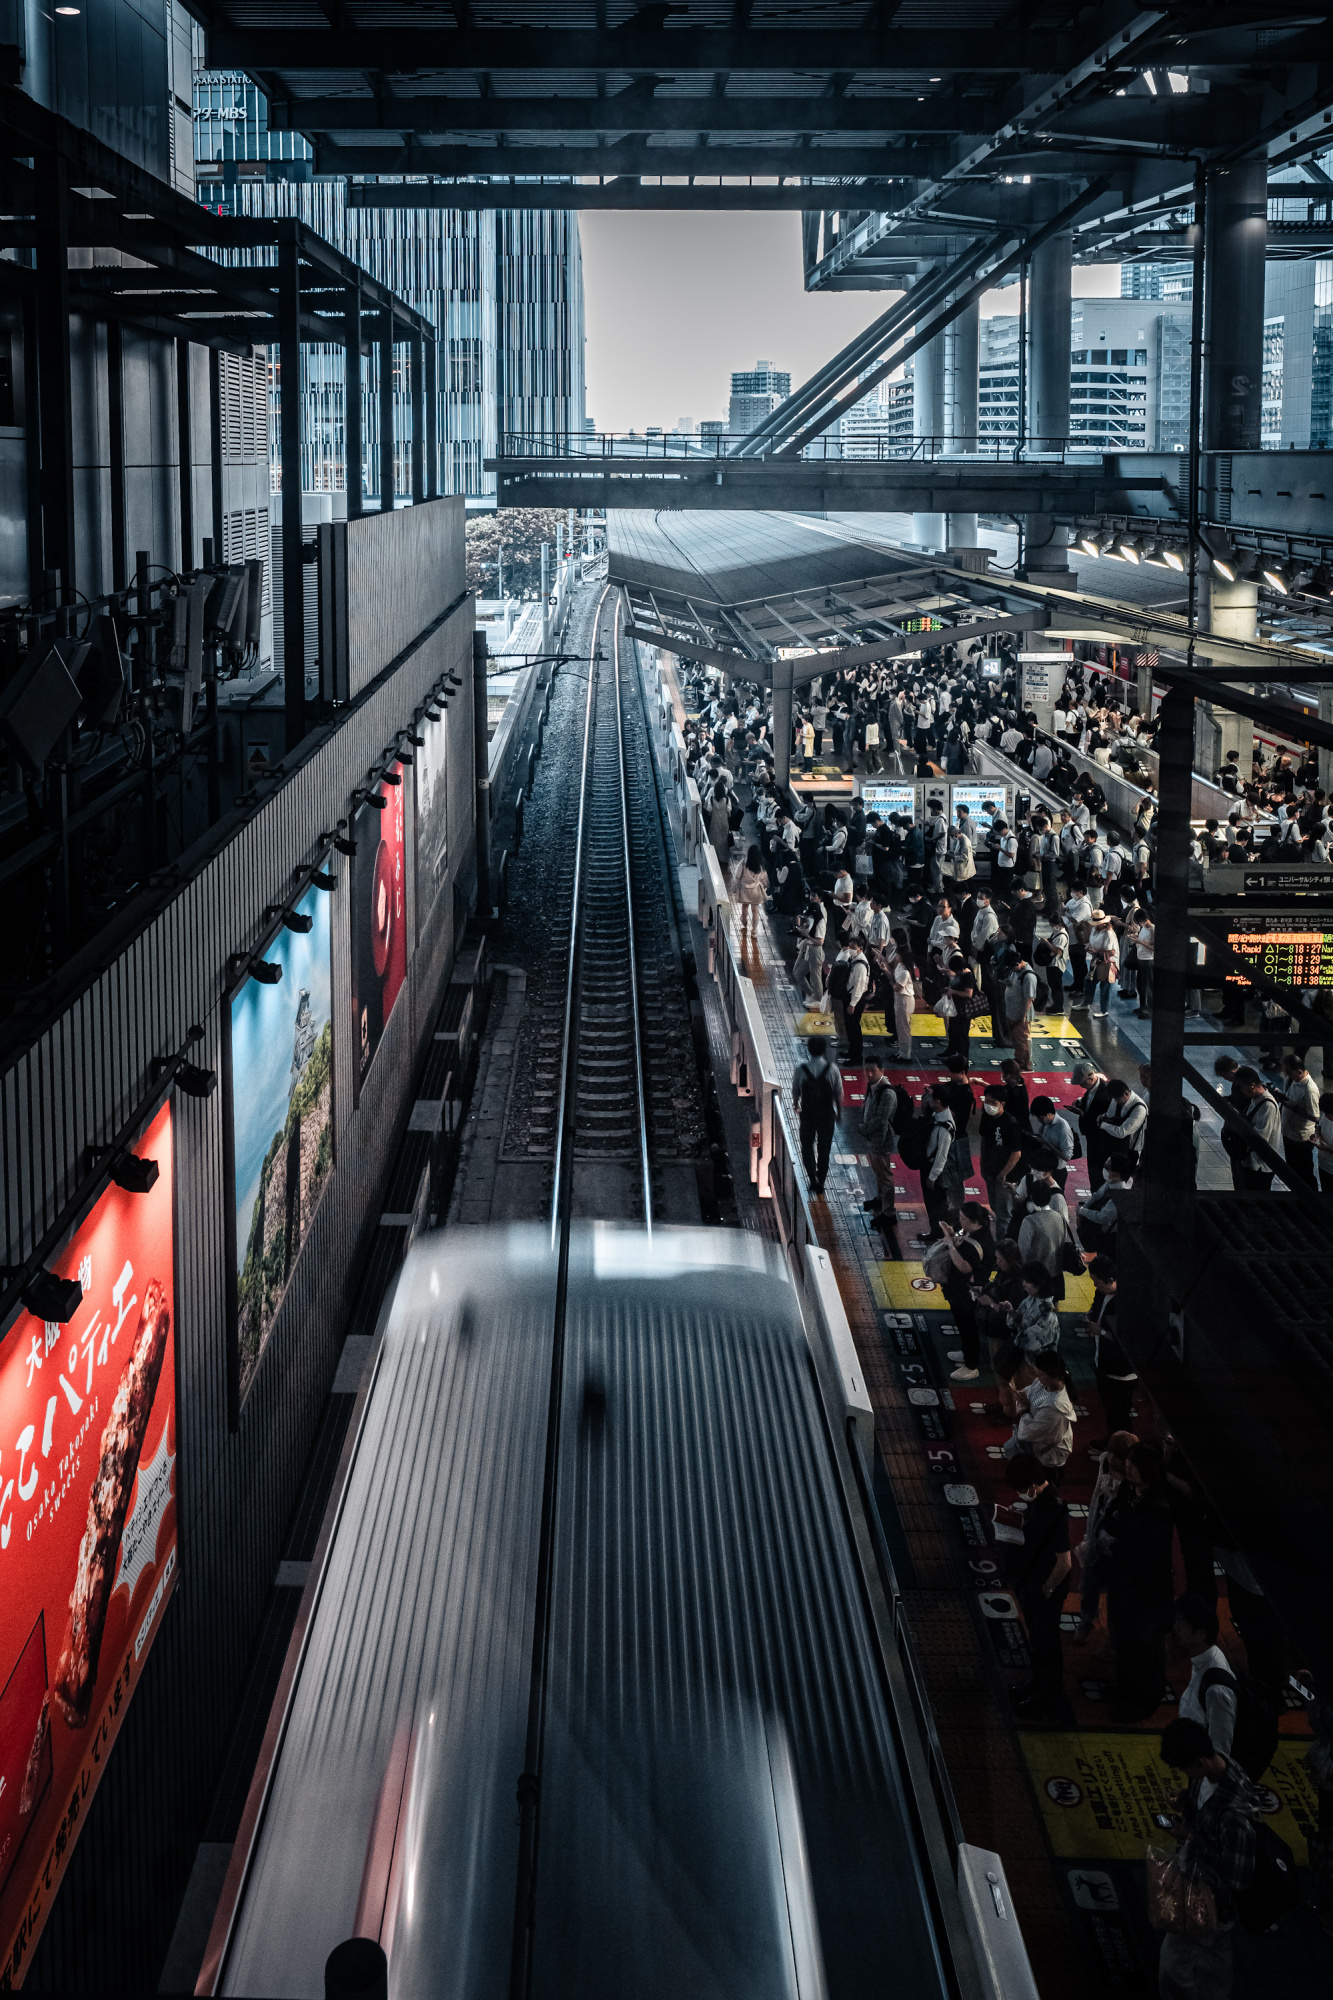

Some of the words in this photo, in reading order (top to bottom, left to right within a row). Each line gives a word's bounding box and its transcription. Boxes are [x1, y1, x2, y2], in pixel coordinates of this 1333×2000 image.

[1259, 877, 1265, 886] 1
[1232, 944, 1261, 953] R.Rapid
[1294, 944, 1321, 953] 18:27
[1294, 955, 1320, 964] 18:29
[1293, 965, 1319, 974] 18:34
[1293, 976, 1319, 985] 18:38
[26, 1254, 92, 1388] 大阪物
[928, 1450, 954, 1461] 5
[27, 1481, 57, 1541] Osaka
[58, 1396, 99, 1480] Takoyaki
[49, 1456, 81, 1523] sweets
[968, 1560, 997, 1573] 6
[1101, 1750, 1114, 1763] off
[1110, 1765, 1131, 1798] getting
[1075, 1758, 1116, 1830] 降車エリア
[1093, 1755, 1128, 1833] ここを空けてください
[1123, 1800, 1135, 1815] for
[1128, 1817, 1144, 1839] Area
